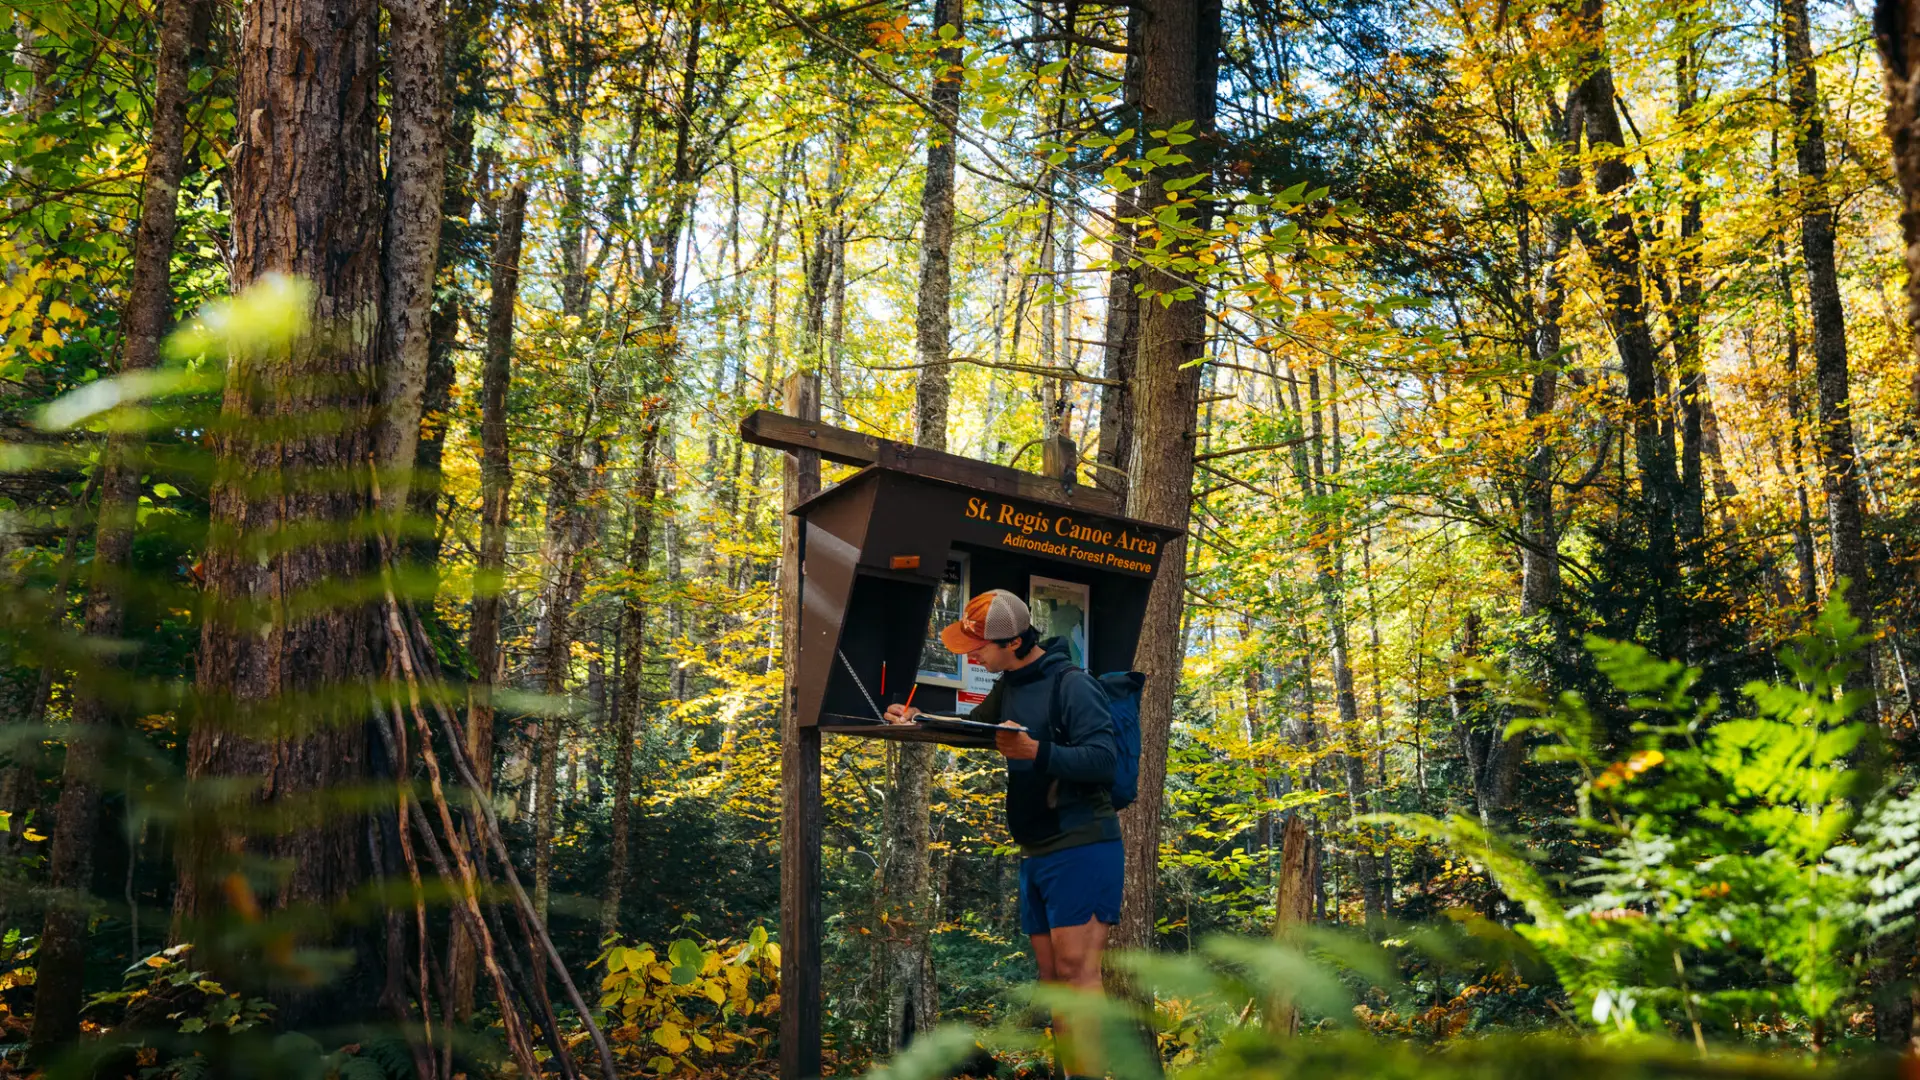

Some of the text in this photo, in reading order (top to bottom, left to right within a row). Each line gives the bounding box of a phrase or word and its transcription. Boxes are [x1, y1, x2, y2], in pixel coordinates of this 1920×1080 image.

[965, 497, 1157, 555] St. Regis Canoe Area
[1003, 533, 1152, 574] Adirondack Forest Preserve
